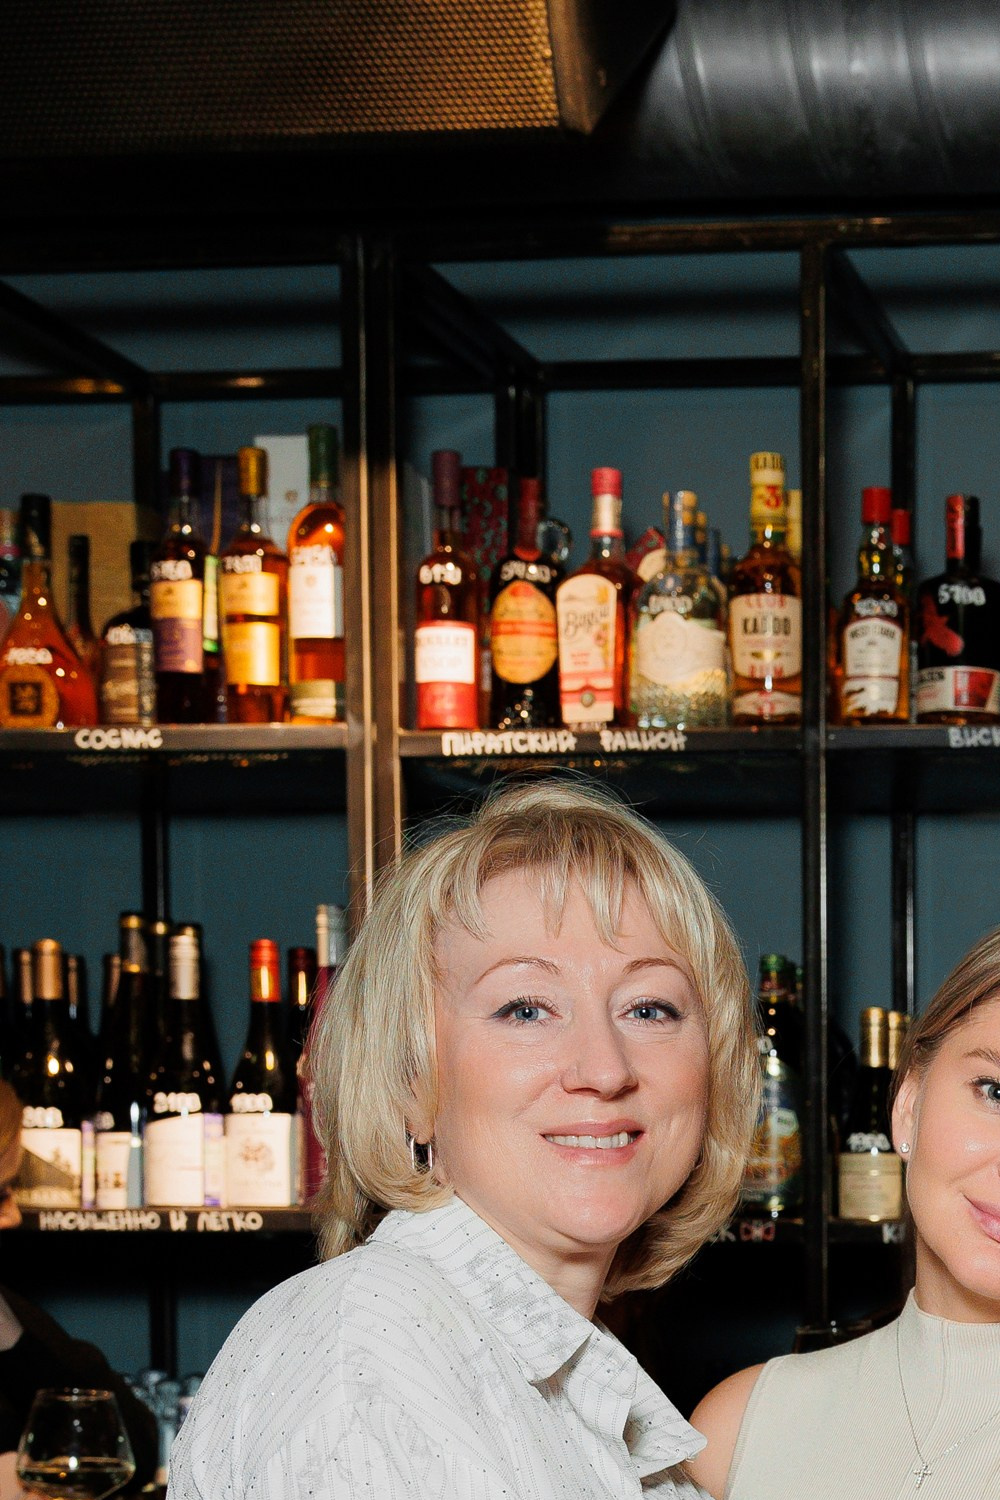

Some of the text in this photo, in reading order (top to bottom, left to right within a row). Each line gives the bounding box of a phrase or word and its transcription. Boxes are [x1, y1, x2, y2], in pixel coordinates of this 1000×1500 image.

[74, 728, 163, 750] COGNAC
[441, 729, 687, 756] ПИРАТСКИЙ РАЦИОН
[196, 1210, 263, 1232] ЛЕГКО
